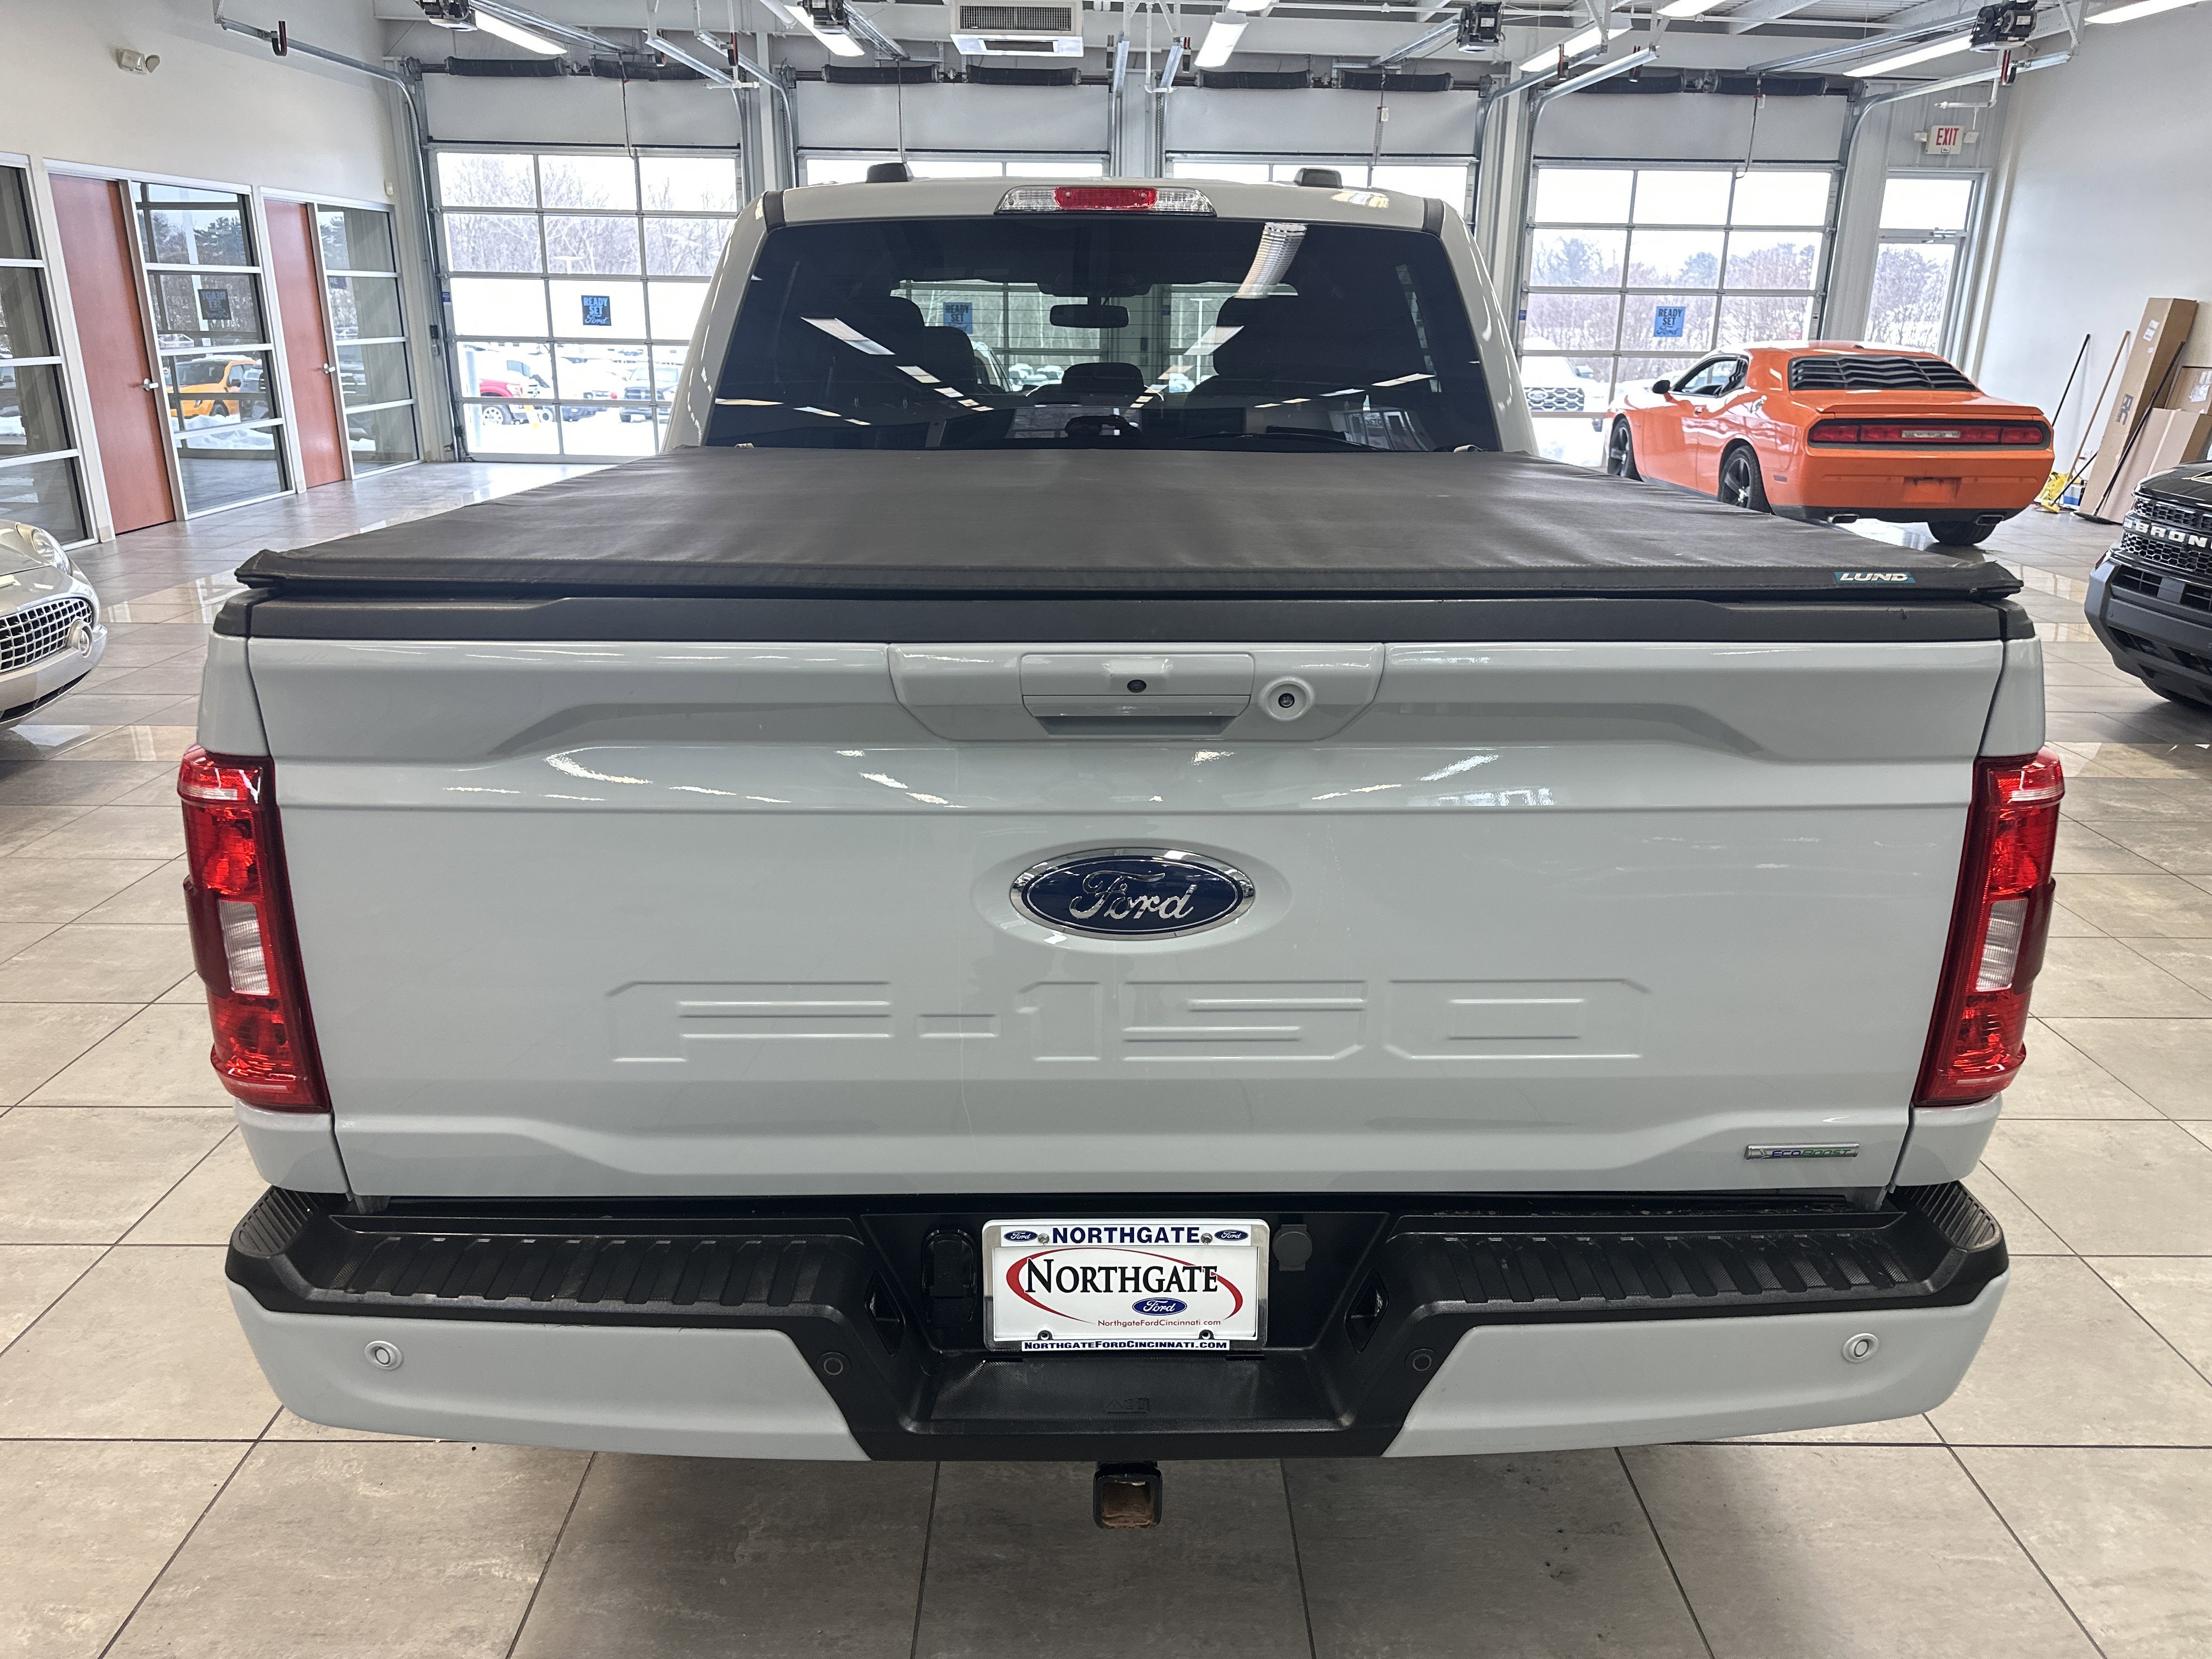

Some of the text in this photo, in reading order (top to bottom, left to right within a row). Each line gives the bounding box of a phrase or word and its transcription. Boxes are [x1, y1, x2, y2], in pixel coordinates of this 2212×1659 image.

[1936, 128, 1959, 145] EXIT
[583, 297, 608, 307] READY
[589, 306, 603, 315] SET
[945, 304, 969, 313] READY
[1658, 308, 1683, 317] READY
[585, 314, 610, 324] Ford
[951, 313, 964, 322] SET
[1662, 317, 1677, 325] SET
[1656, 325, 1680, 335] Ford
[2135, 522, 2212, 549] BRON
[1839, 572, 1908, 582] LUND
[1069, 870, 1198, 919] Ford
[606, 979, 1649, 1063] F-150
[1052, 1227, 1200, 1244] NORTHGATE
[1221, 1231, 1242, 1239] Ford
[1024, 1259, 1218, 1294] NORTHGATE
[1143, 1300, 1176, 1312] Ford
[1098, 1319, 1221, 1328] NorthgateFordCincinnati.com
